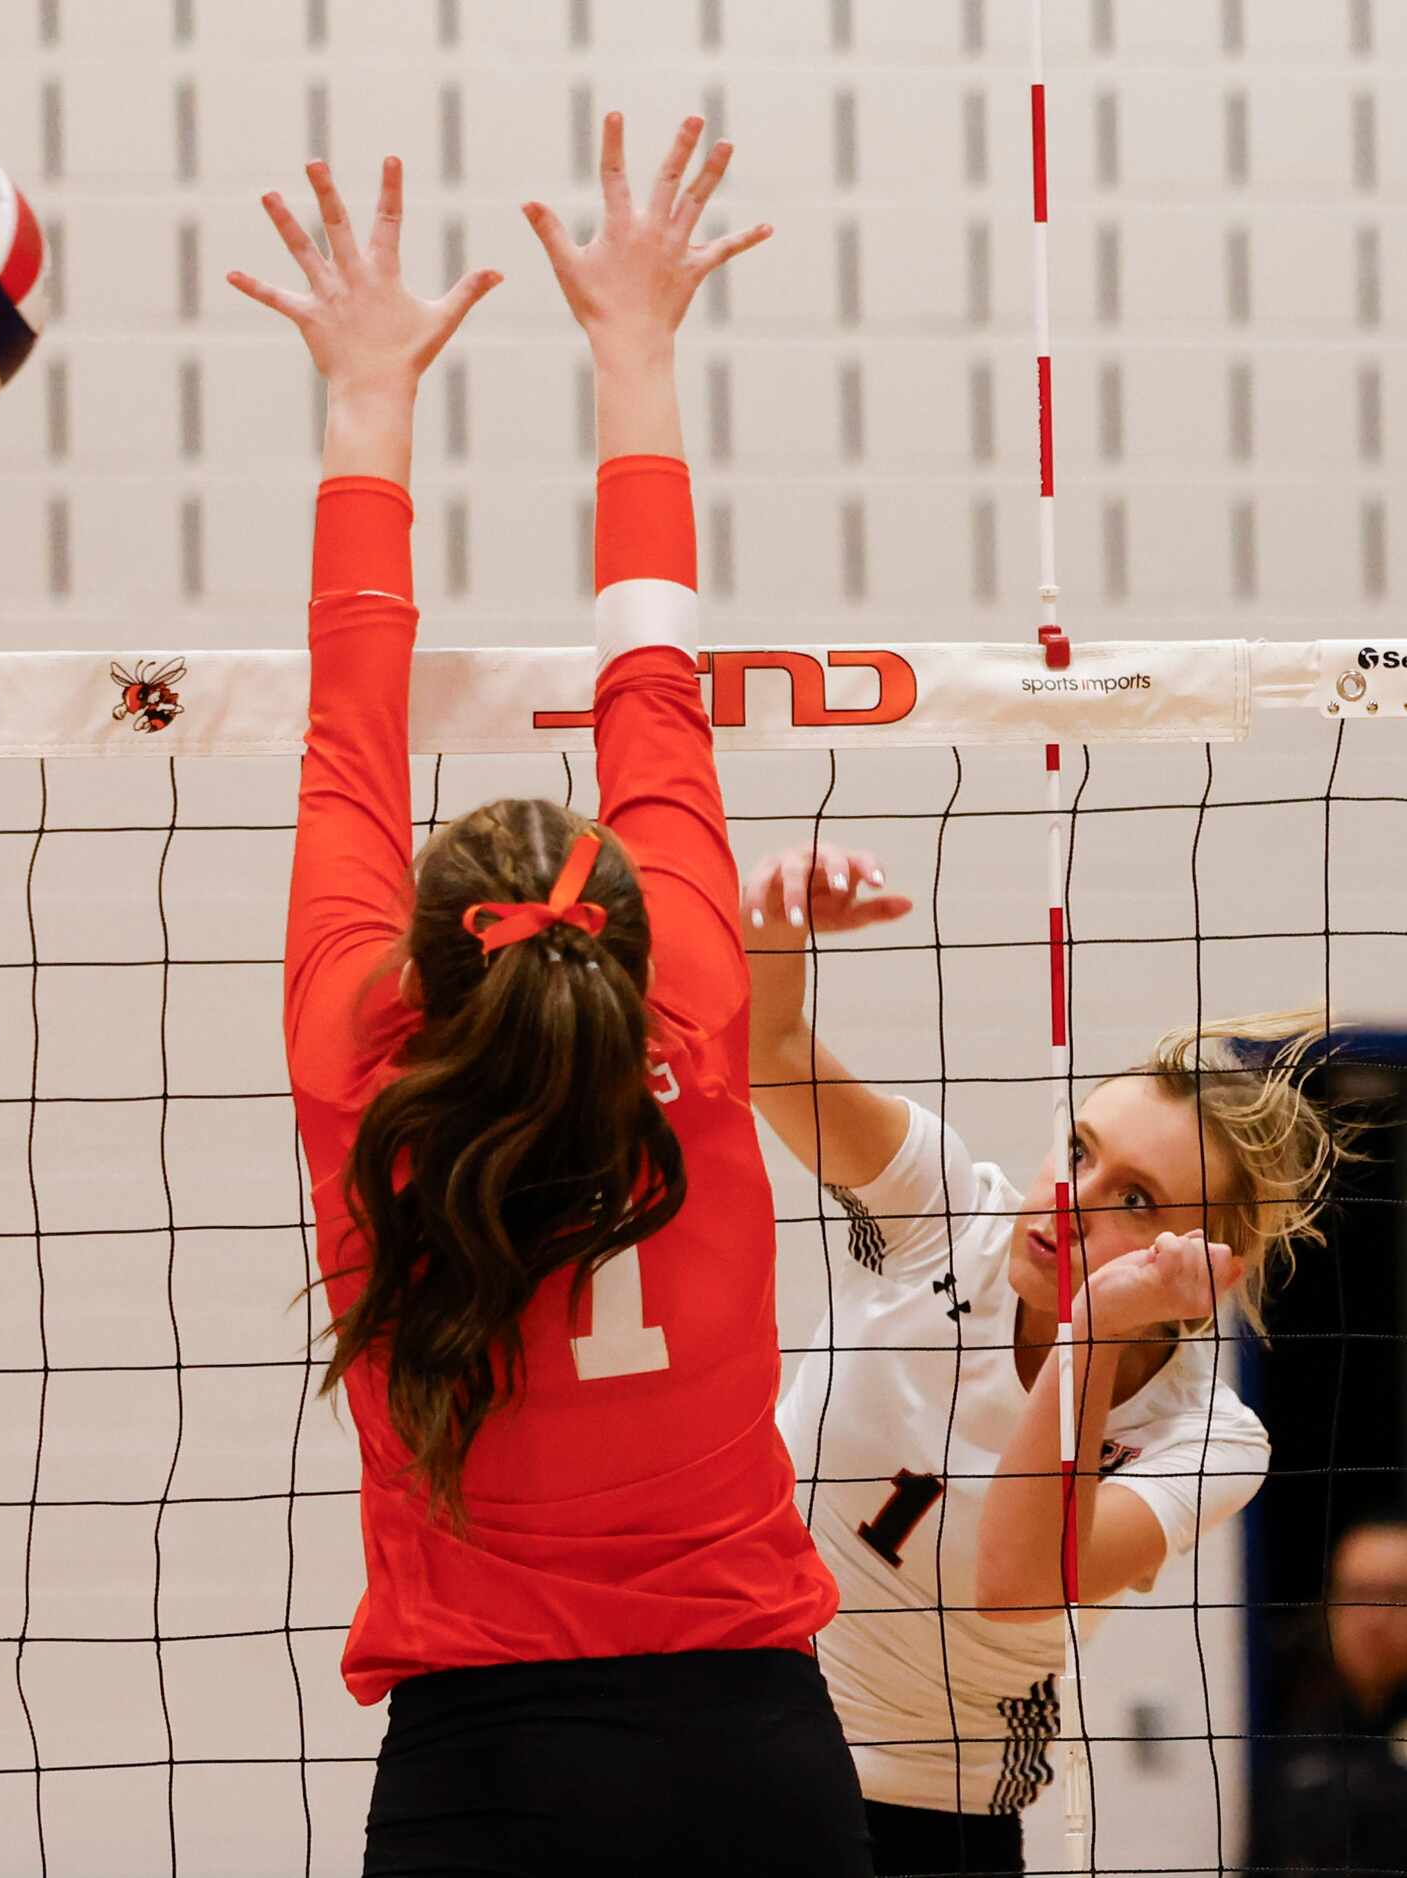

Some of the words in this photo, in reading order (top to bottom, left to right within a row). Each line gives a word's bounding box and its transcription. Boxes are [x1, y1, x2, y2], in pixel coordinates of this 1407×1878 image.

[1021, 677, 1079, 694] sports
[1081, 672, 1152, 694] imports
[856, 1466, 945, 1570] 1
